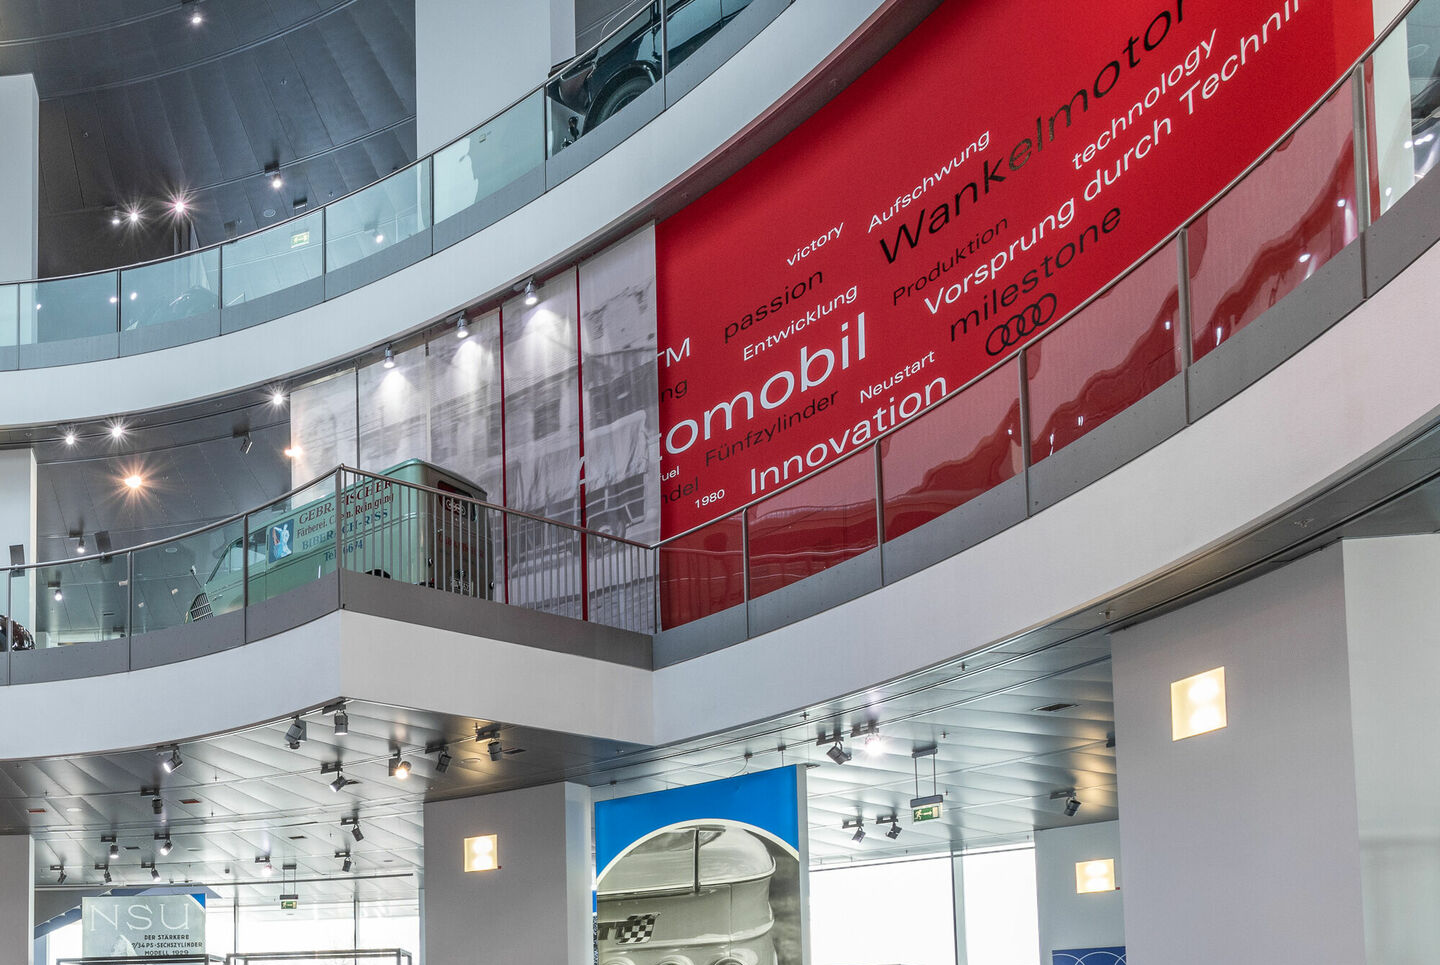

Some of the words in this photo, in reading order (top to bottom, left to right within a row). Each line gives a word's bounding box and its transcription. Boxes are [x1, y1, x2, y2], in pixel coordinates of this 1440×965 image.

[1072, 28, 1217, 170] technology
[867, 130, 991, 234] Aufschwung
[924, 197, 1076, 316] Vorsprung
[1083, 117, 1172, 202] durch
[1179, 0, 1300, 116] Techni
[786, 223, 844, 267] victory
[893, 217, 1009, 307] Produktion
[950, 206, 1122, 343] milestone
[724, 271, 824, 344] passion
[743, 285, 858, 362] Entwicklung
[860, 350, 936, 404] Neustart
[705, 390, 839, 468] Fünfzylinder
[750, 373, 949, 495] Innovation
[299, 502, 335, 525] GEBR.
[694, 488, 726, 510] 1980
[89, 903, 191, 932] NSU
